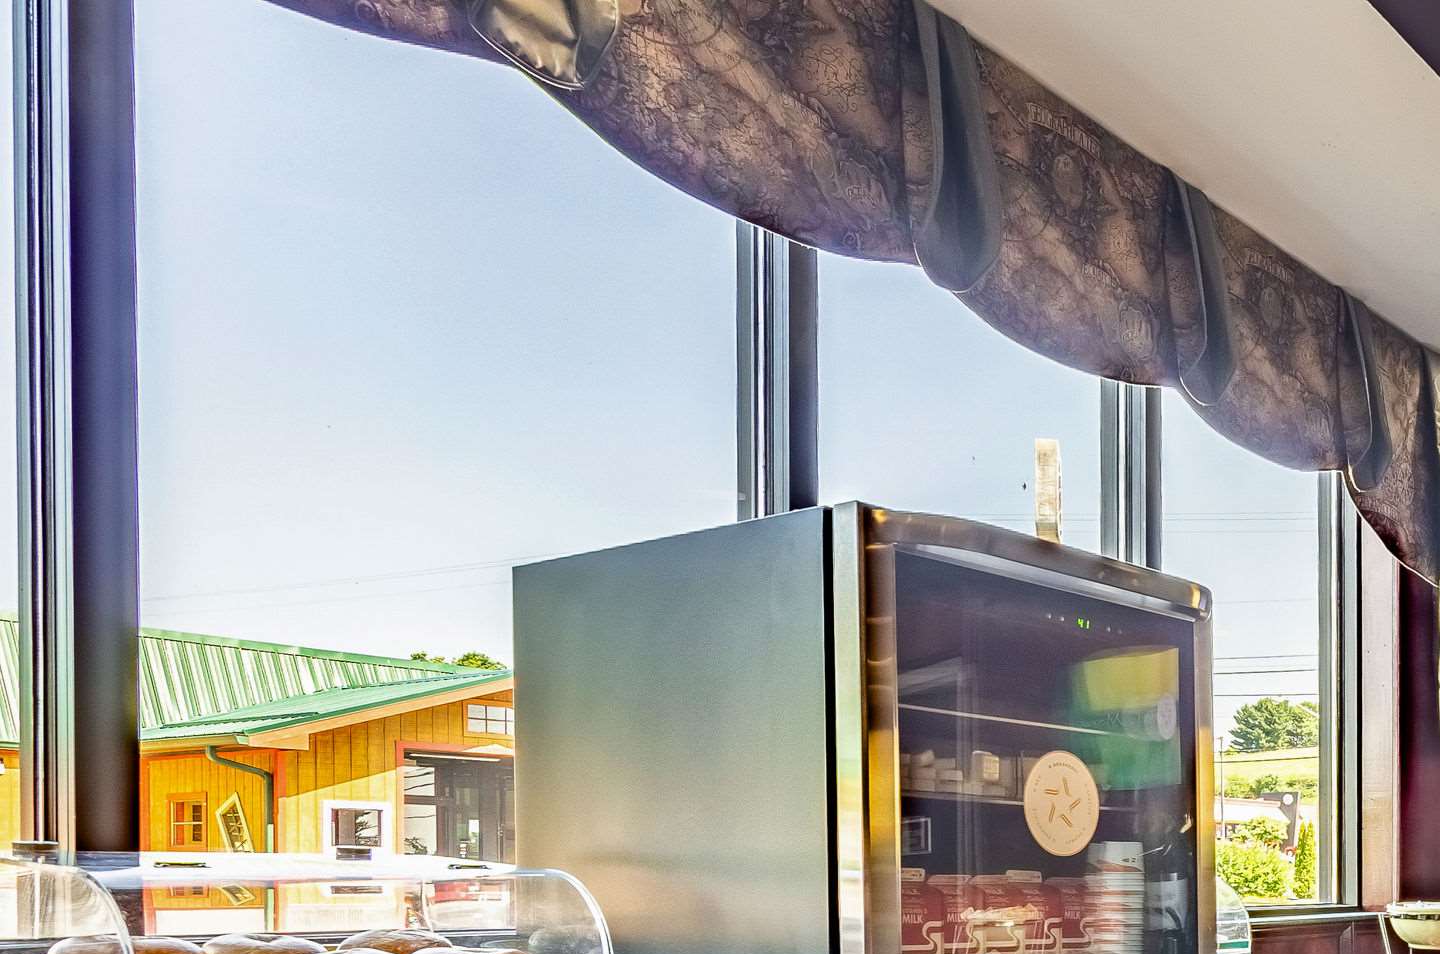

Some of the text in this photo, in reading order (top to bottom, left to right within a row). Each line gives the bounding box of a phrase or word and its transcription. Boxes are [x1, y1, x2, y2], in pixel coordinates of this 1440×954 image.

[1077, 617, 1090, 630] 41
[902, 913, 924, 924] MILK
[1064, 910, 1081, 920] MILK
